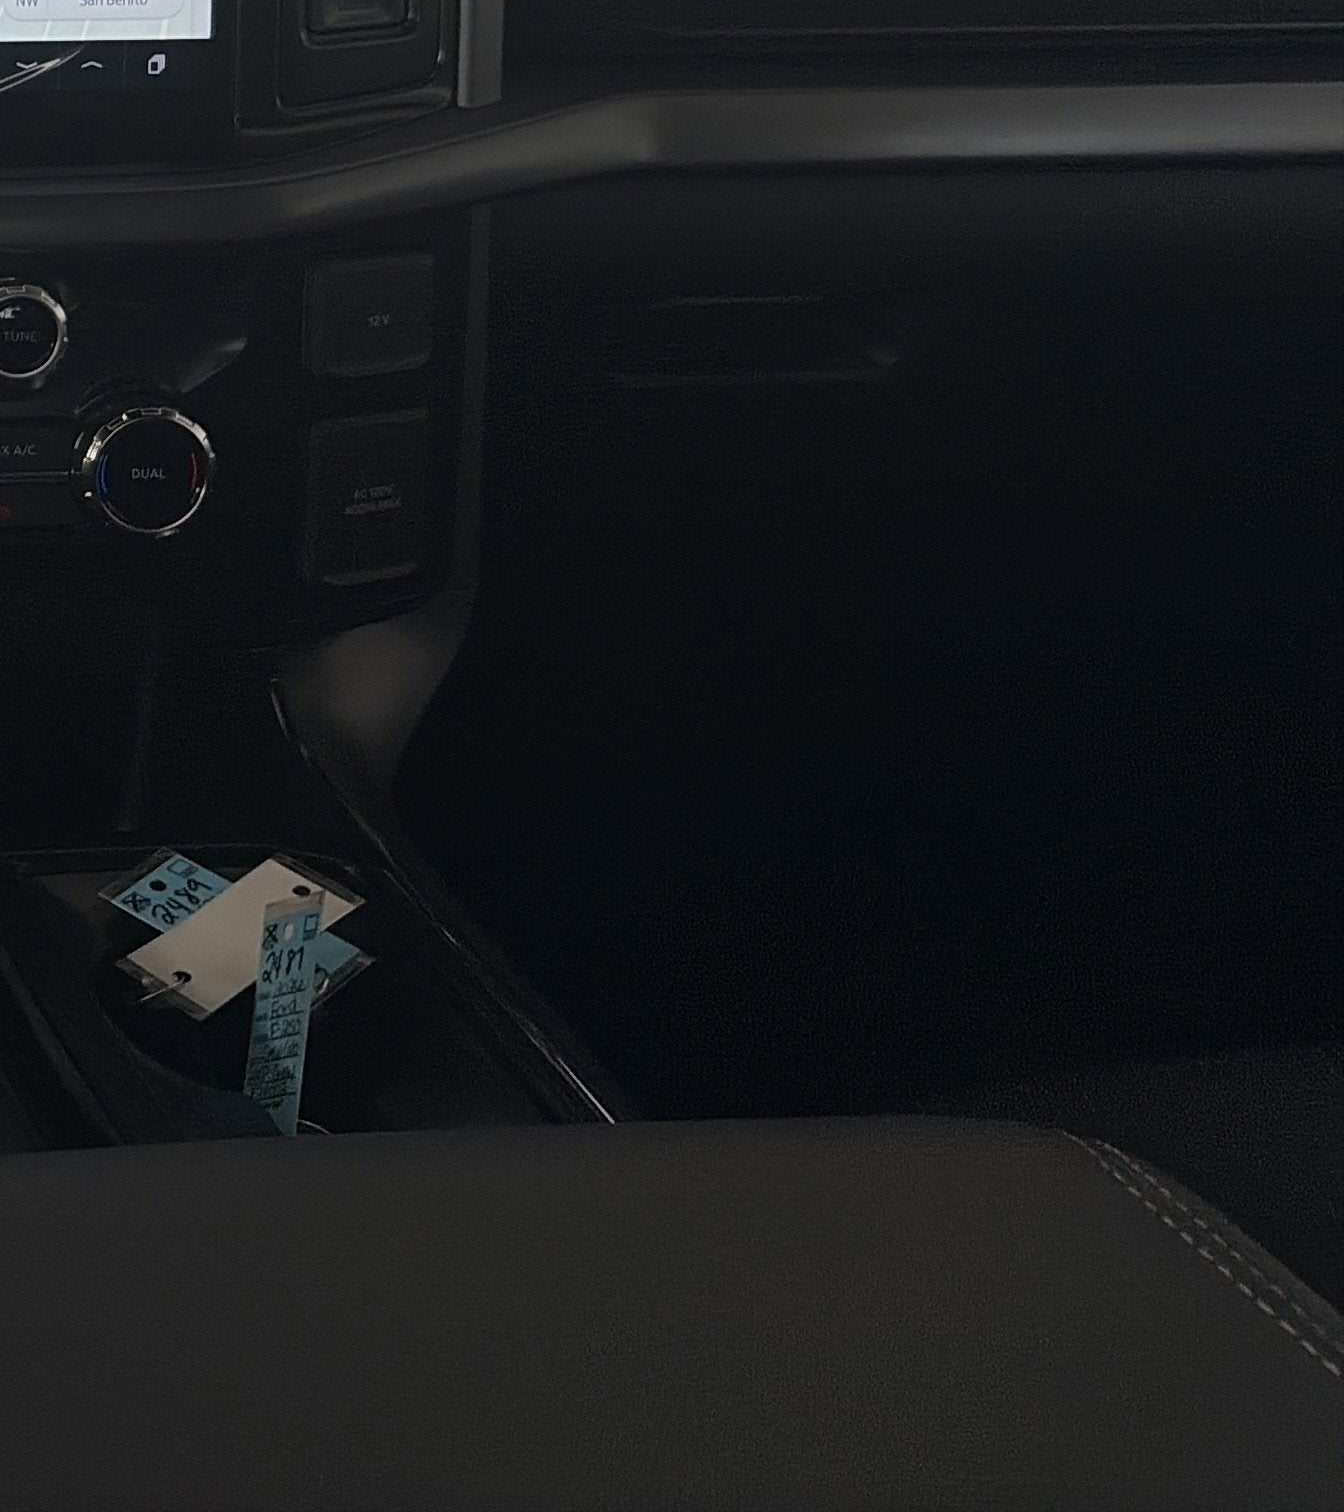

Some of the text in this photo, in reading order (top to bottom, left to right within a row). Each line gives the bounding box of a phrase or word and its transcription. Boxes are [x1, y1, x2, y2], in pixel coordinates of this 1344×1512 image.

[2, 330, 37, 343] TUNE
[13, 444, 37, 456] A/C
[131, 468, 166, 479] DUAL
